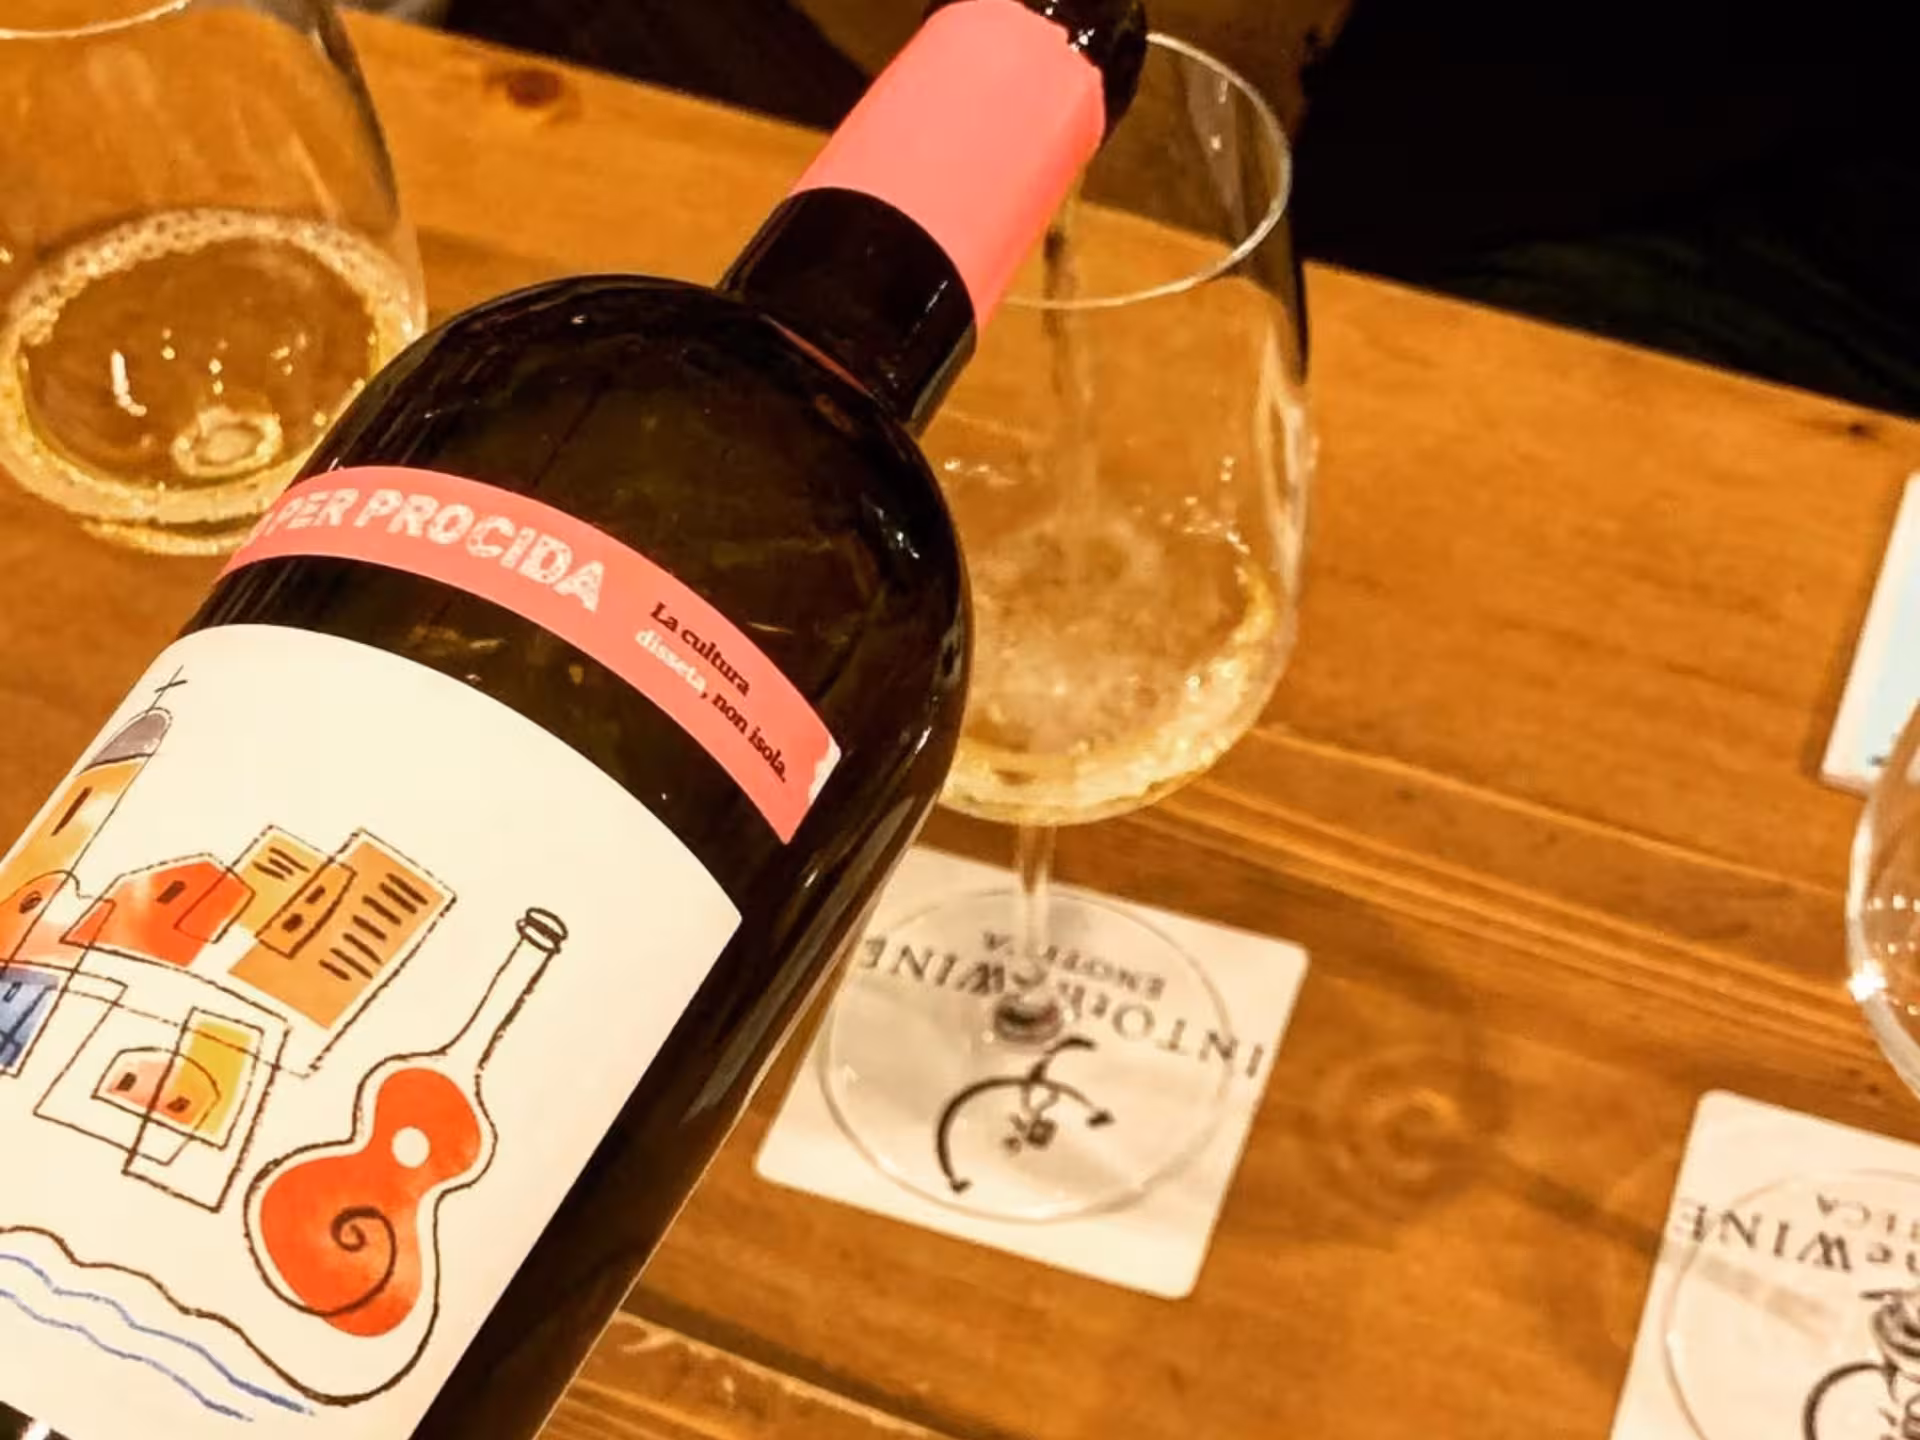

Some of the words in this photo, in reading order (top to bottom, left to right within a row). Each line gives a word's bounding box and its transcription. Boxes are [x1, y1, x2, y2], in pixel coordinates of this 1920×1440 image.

[264, 486, 360, 536] PER
[354, 488, 605, 613] PROCIDA
[651, 601, 680, 633] La
[681, 628, 750, 697] cultura
[711, 693, 749, 734] non
[747, 726, 787, 784] isola.
